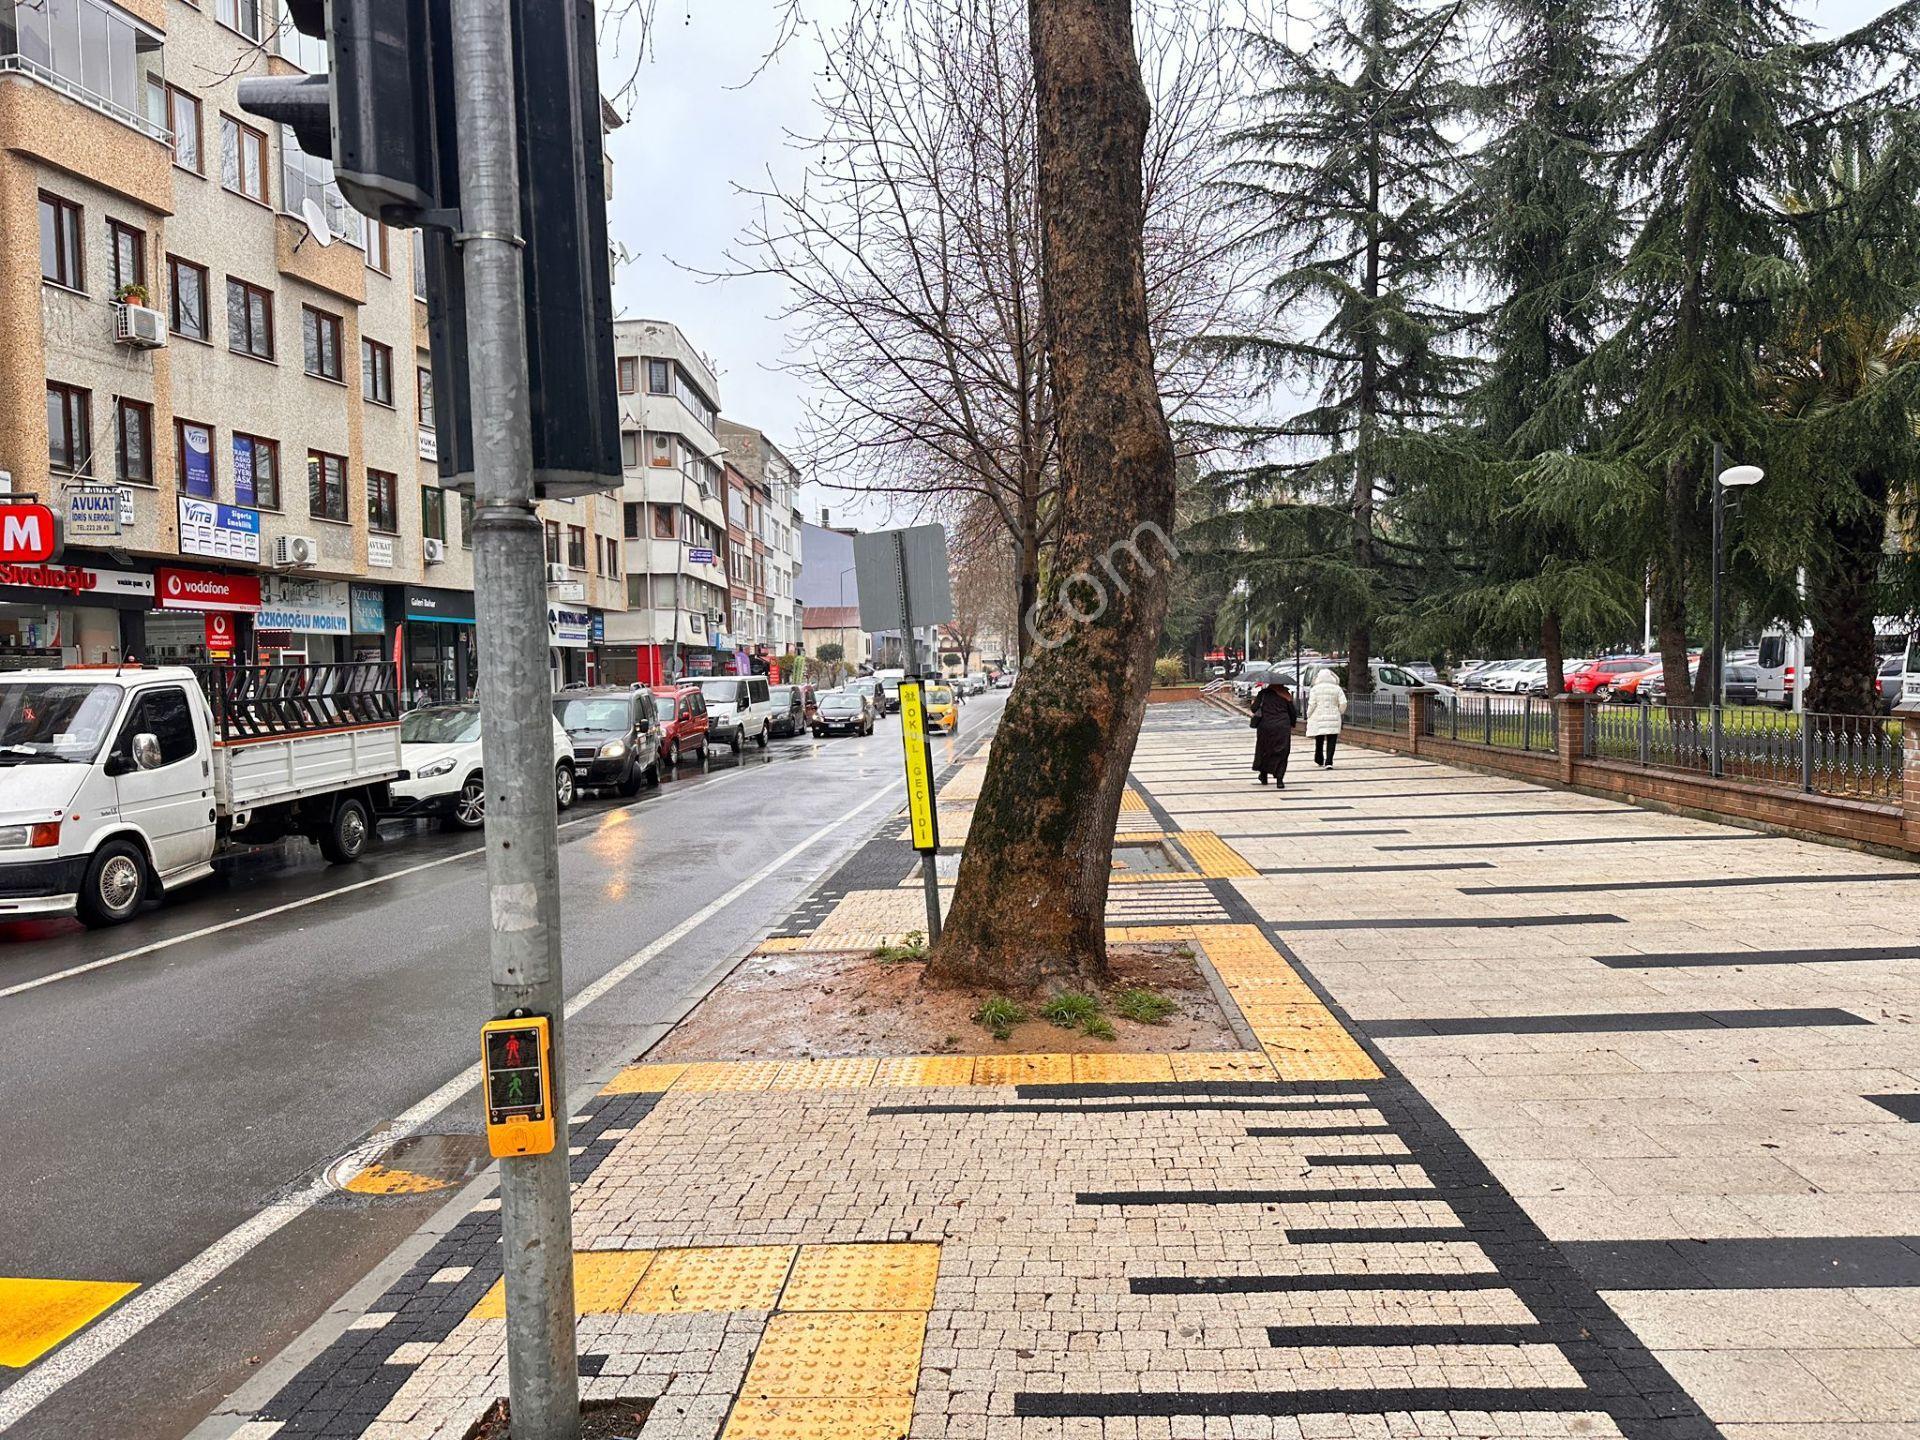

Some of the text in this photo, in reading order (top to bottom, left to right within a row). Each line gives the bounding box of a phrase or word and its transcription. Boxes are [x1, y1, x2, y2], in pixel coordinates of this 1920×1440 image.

[71, 496, 115, 511] AVUKAT
[231, 509, 252, 520] Sigorta
[3, 515, 42, 551] M
[369, 541, 391, 550] AVUKAT
[184, 580, 230, 595] vodafone
